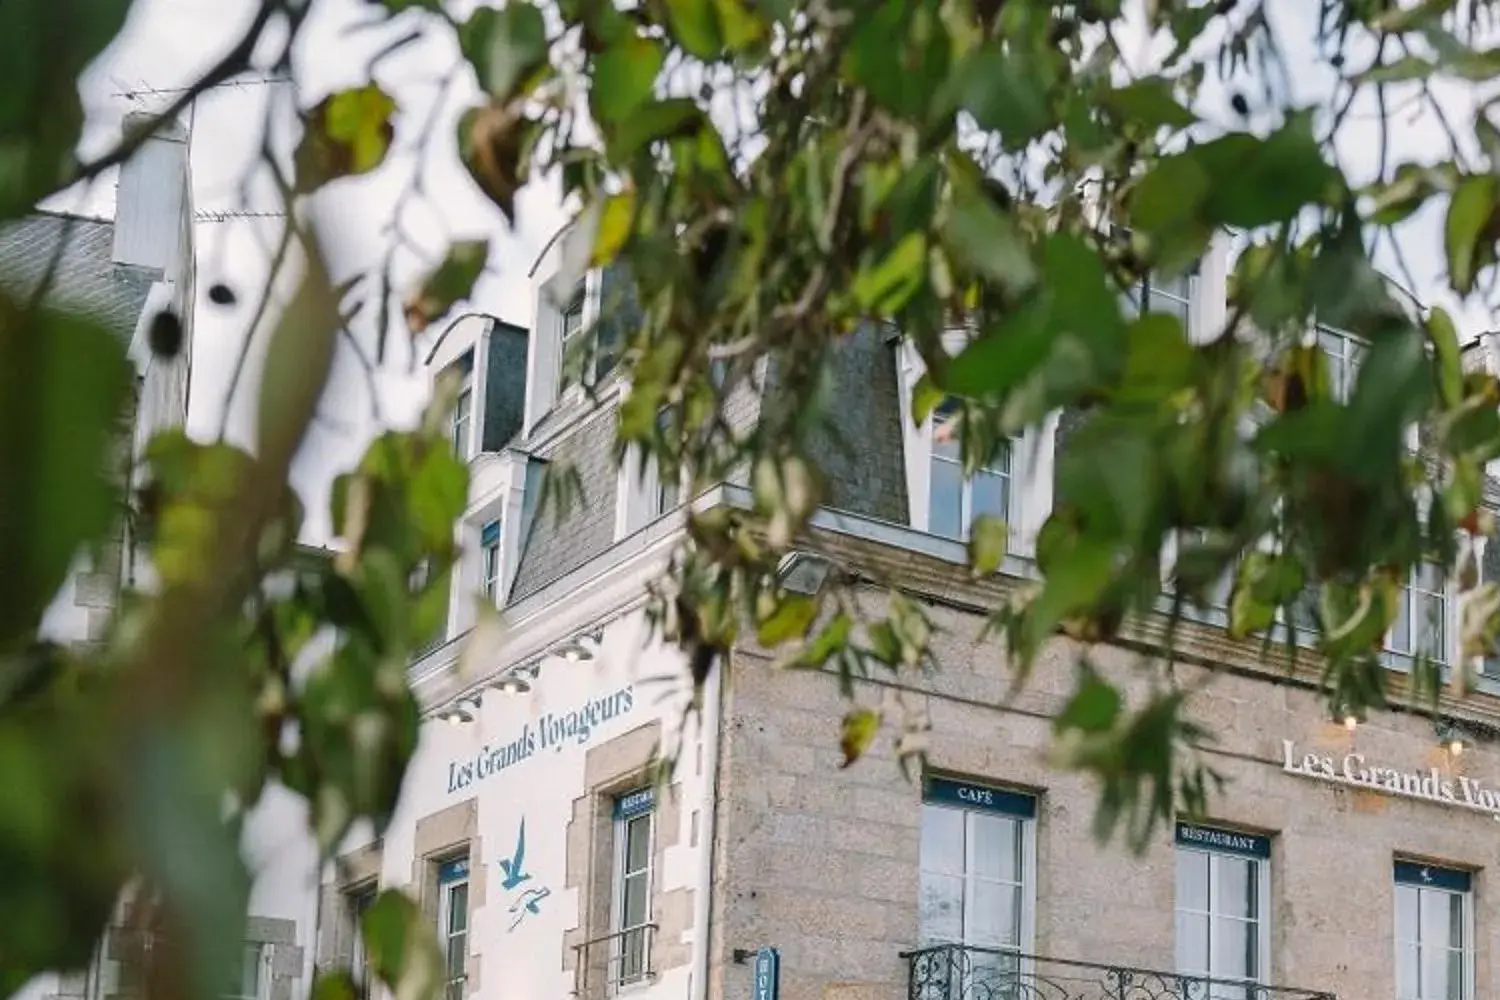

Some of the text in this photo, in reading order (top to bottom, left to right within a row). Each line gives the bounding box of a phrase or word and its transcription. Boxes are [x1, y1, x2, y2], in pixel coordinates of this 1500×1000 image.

[447, 685, 633, 794] Les Grands Voyageurs
[1283, 739, 1334, 779] Les
[1343, 753, 1454, 802] Grands
